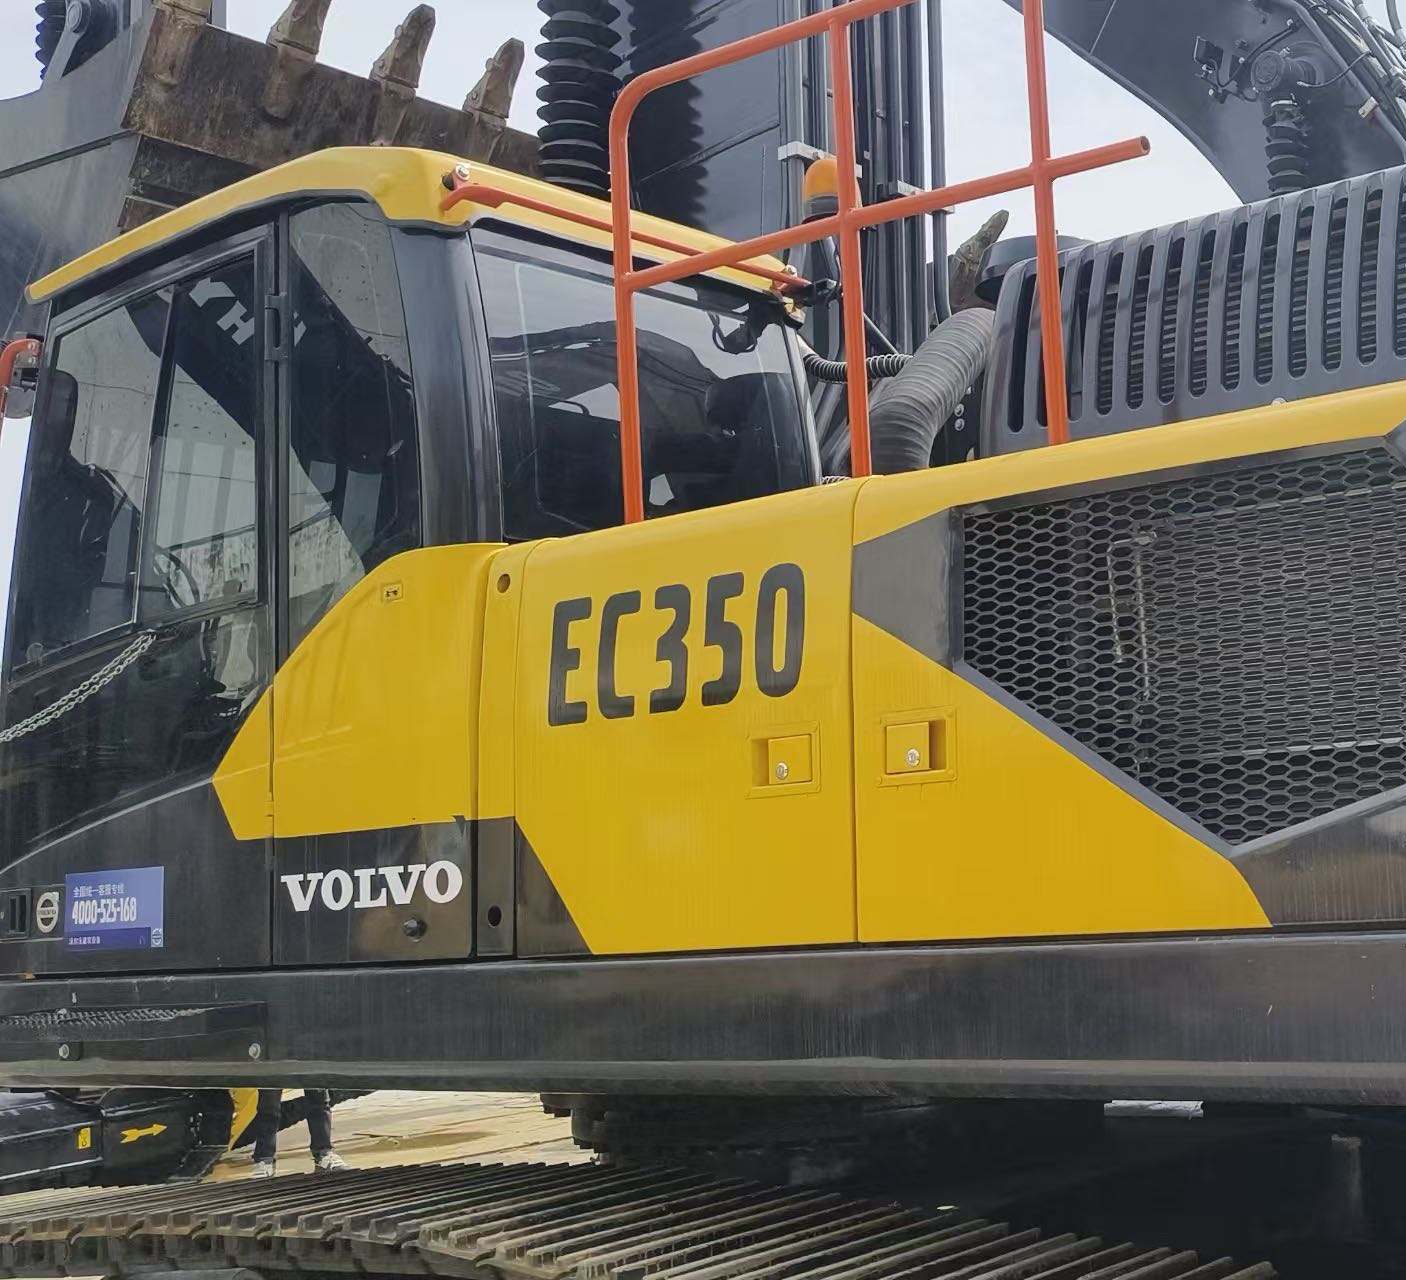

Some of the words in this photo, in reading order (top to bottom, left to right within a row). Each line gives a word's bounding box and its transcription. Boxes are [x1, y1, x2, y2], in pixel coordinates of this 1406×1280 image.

[548, 563, 805, 727] EC350
[71, 897, 137, 925] 4000-525-168
[280, 860, 463, 912] VOLVO
